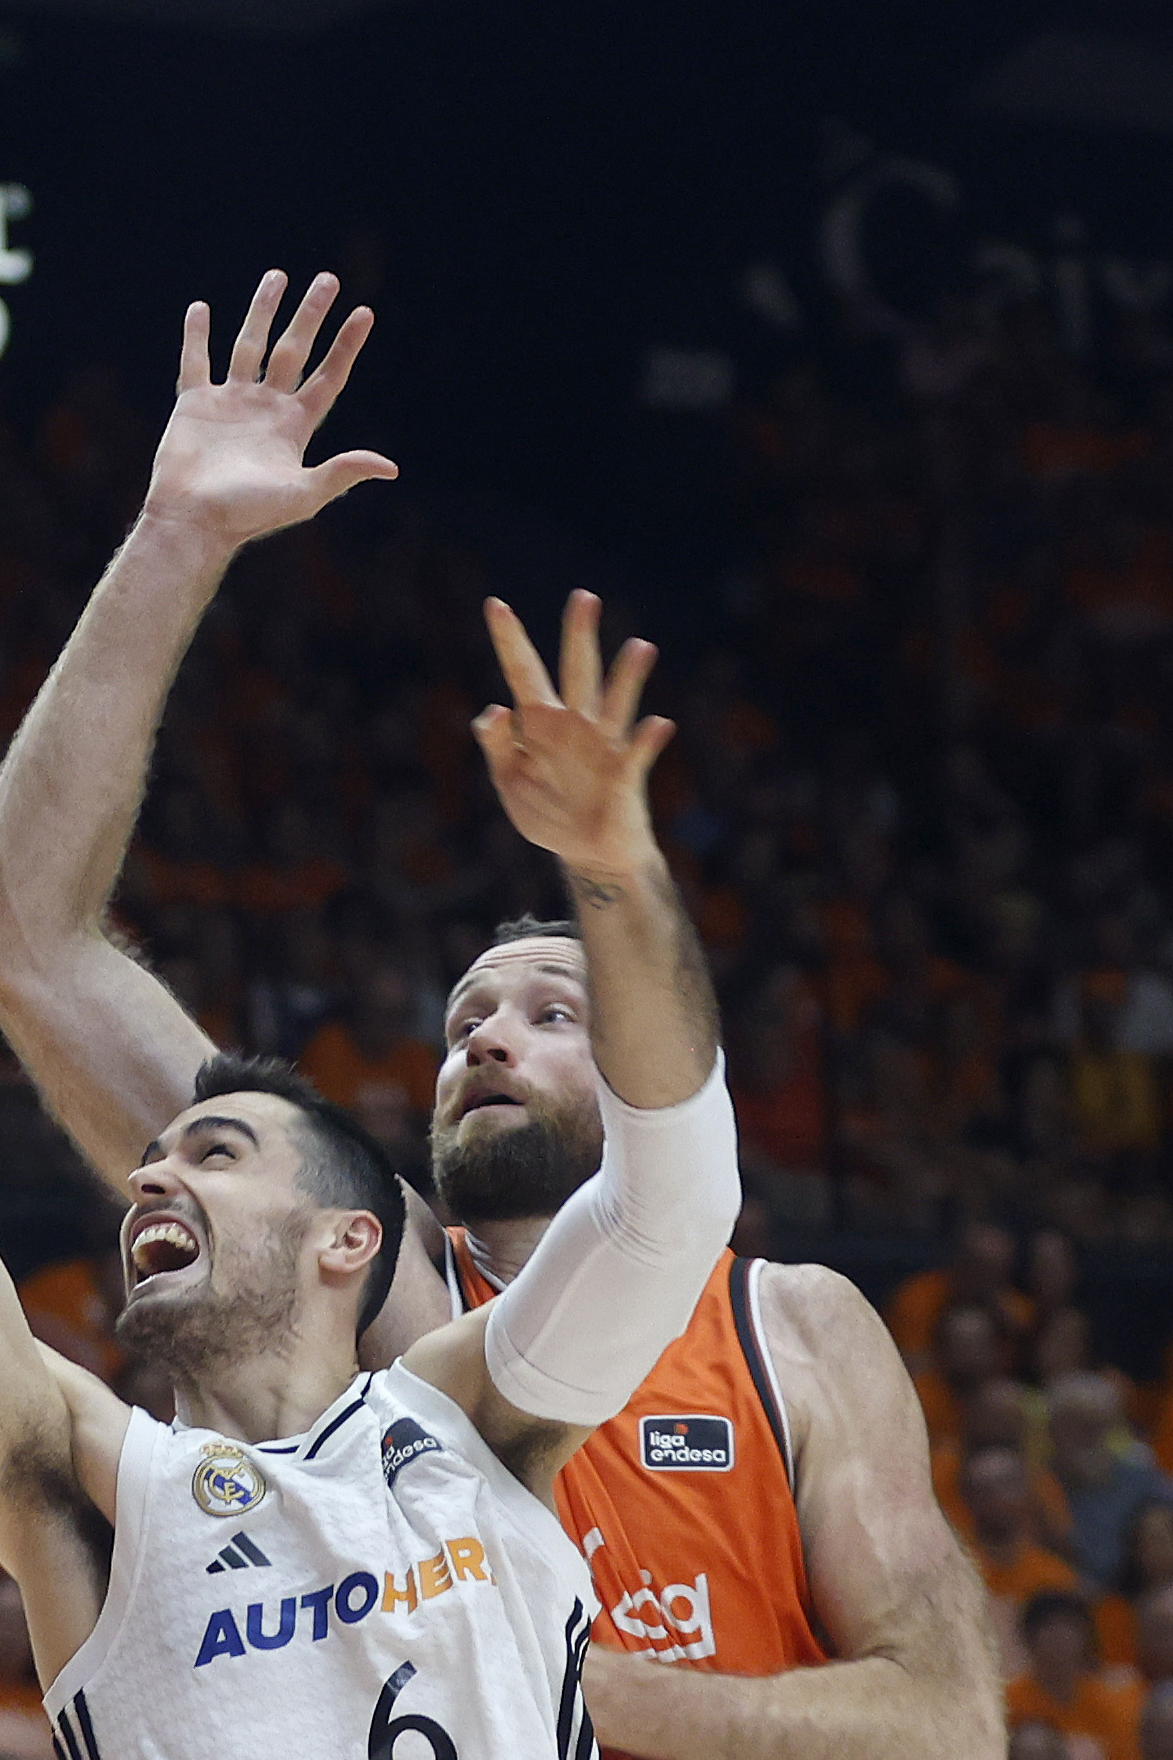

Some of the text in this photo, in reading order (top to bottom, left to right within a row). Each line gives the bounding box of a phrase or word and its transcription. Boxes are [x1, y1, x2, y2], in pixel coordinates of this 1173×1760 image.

[649, 1431, 685, 1449] liga
[650, 1445, 726, 1462] endesa
[384, 1437, 438, 1481] ndesa
[194, 1536, 497, 1668] AUTOHER
